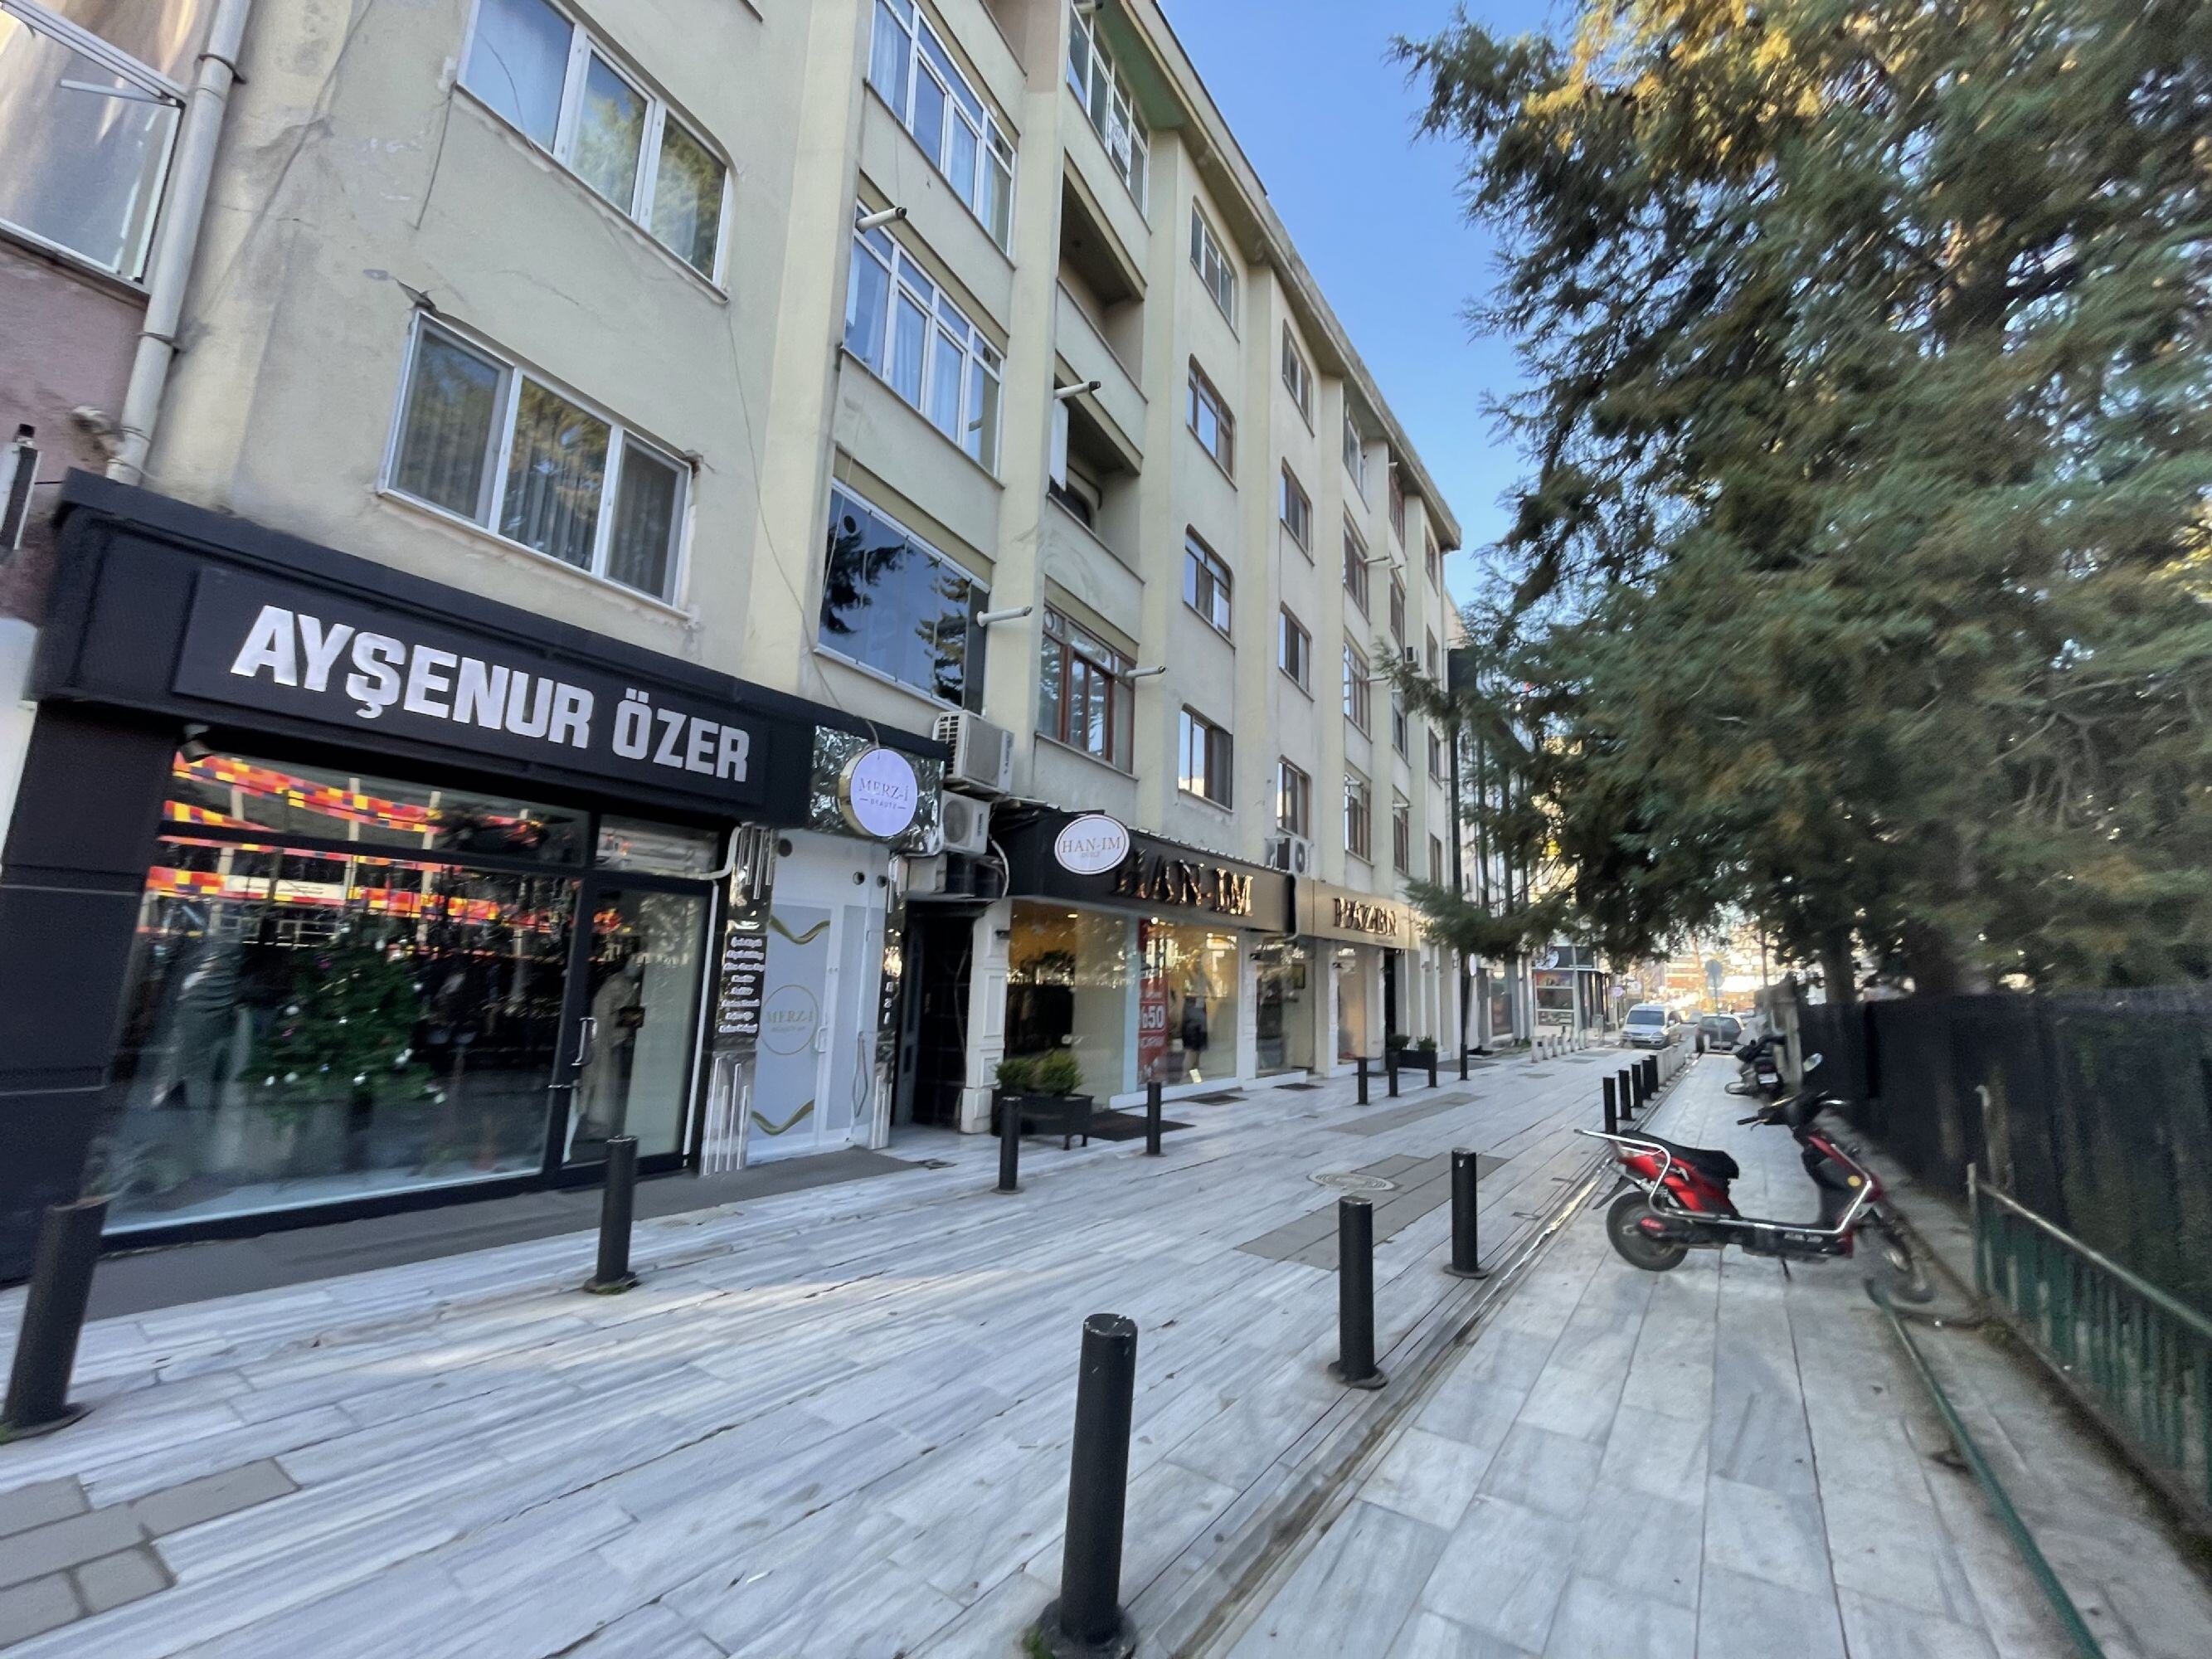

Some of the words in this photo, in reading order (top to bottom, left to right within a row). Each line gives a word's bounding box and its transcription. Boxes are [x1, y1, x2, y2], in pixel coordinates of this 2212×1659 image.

[230, 605, 596, 749] AYŞENUR
[611, 688, 751, 783] ÖZER
[1062, 836, 1121, 854] HAN-IM
